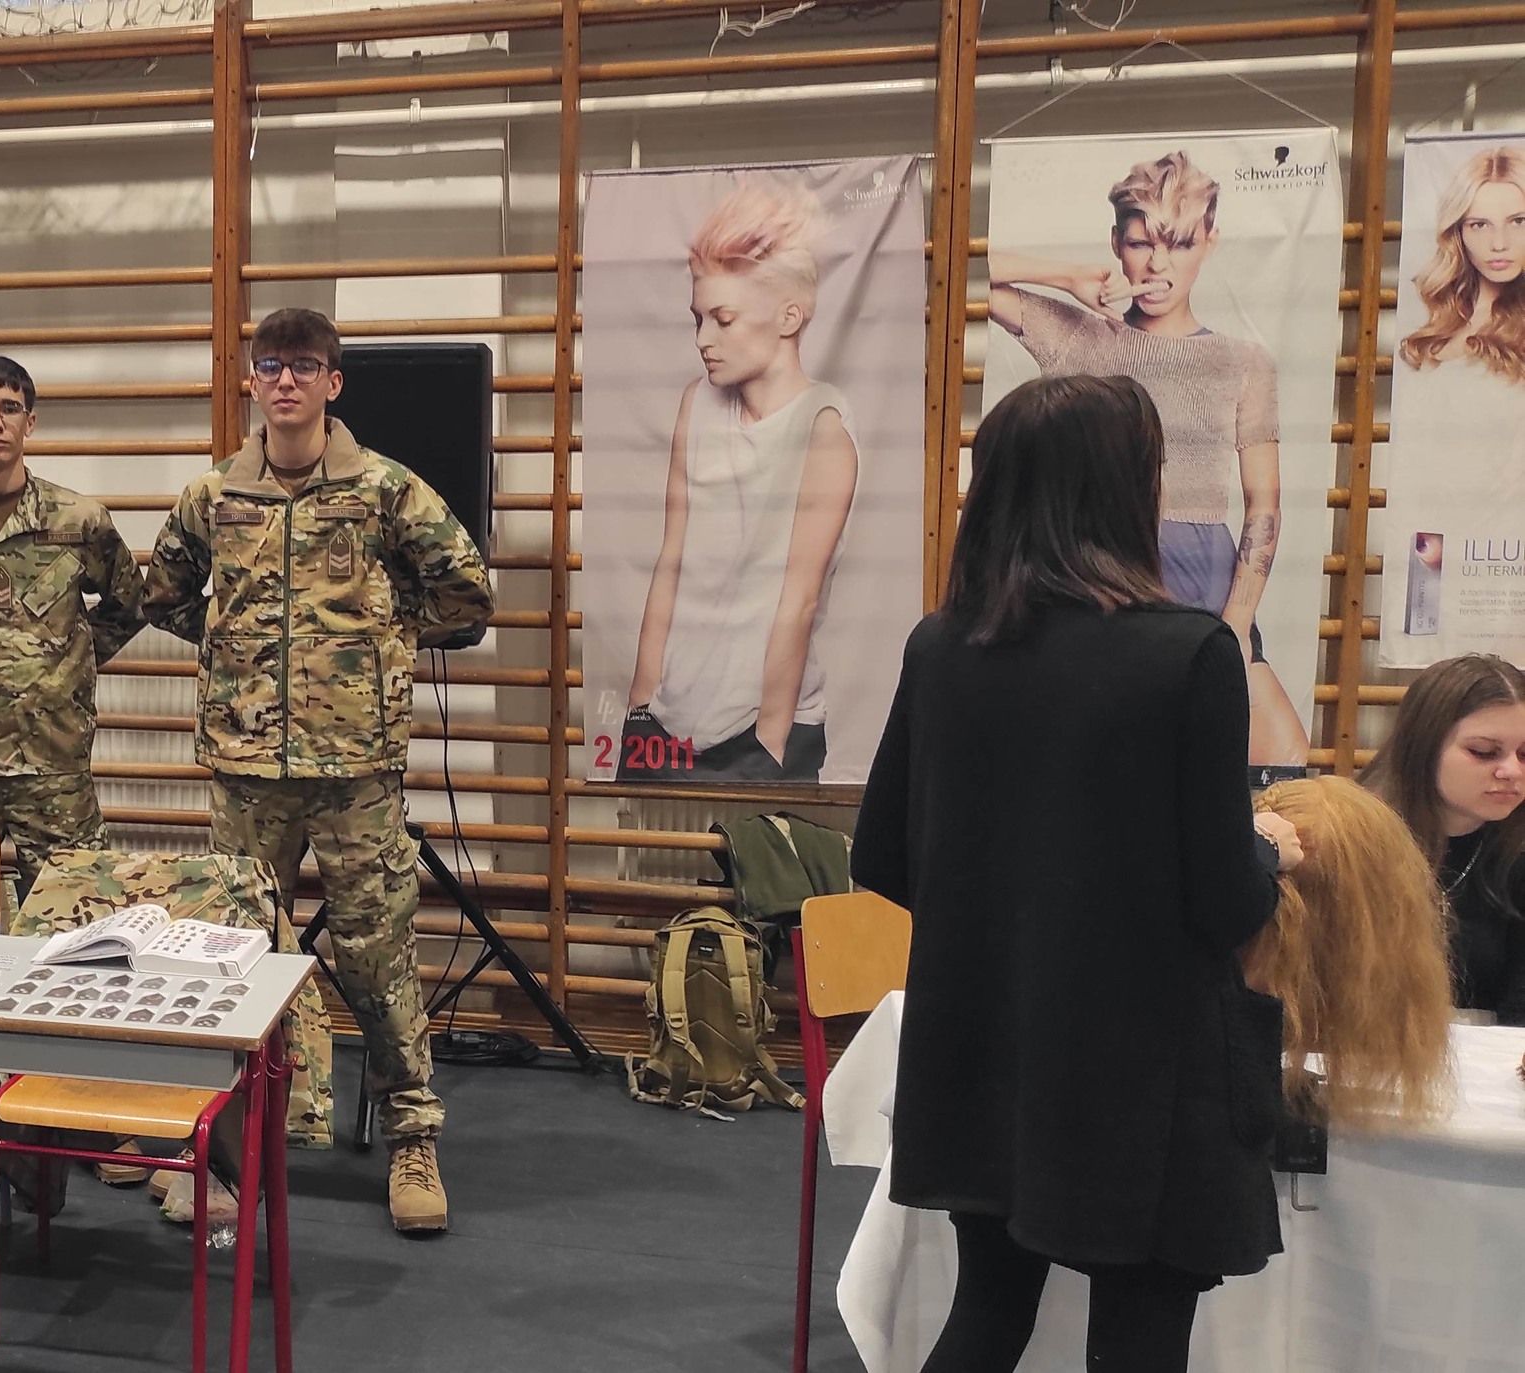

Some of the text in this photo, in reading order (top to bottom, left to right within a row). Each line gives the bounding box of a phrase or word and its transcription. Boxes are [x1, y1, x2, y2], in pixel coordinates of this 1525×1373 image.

[1235, 162, 1328, 180] Schwarzkopf
[843, 183, 908, 201] Schwarkopf
[1464, 539, 1525, 561] ILLU
[1487, 565, 1525, 577] TERM
[594, 735, 693, 769] 2 2011
